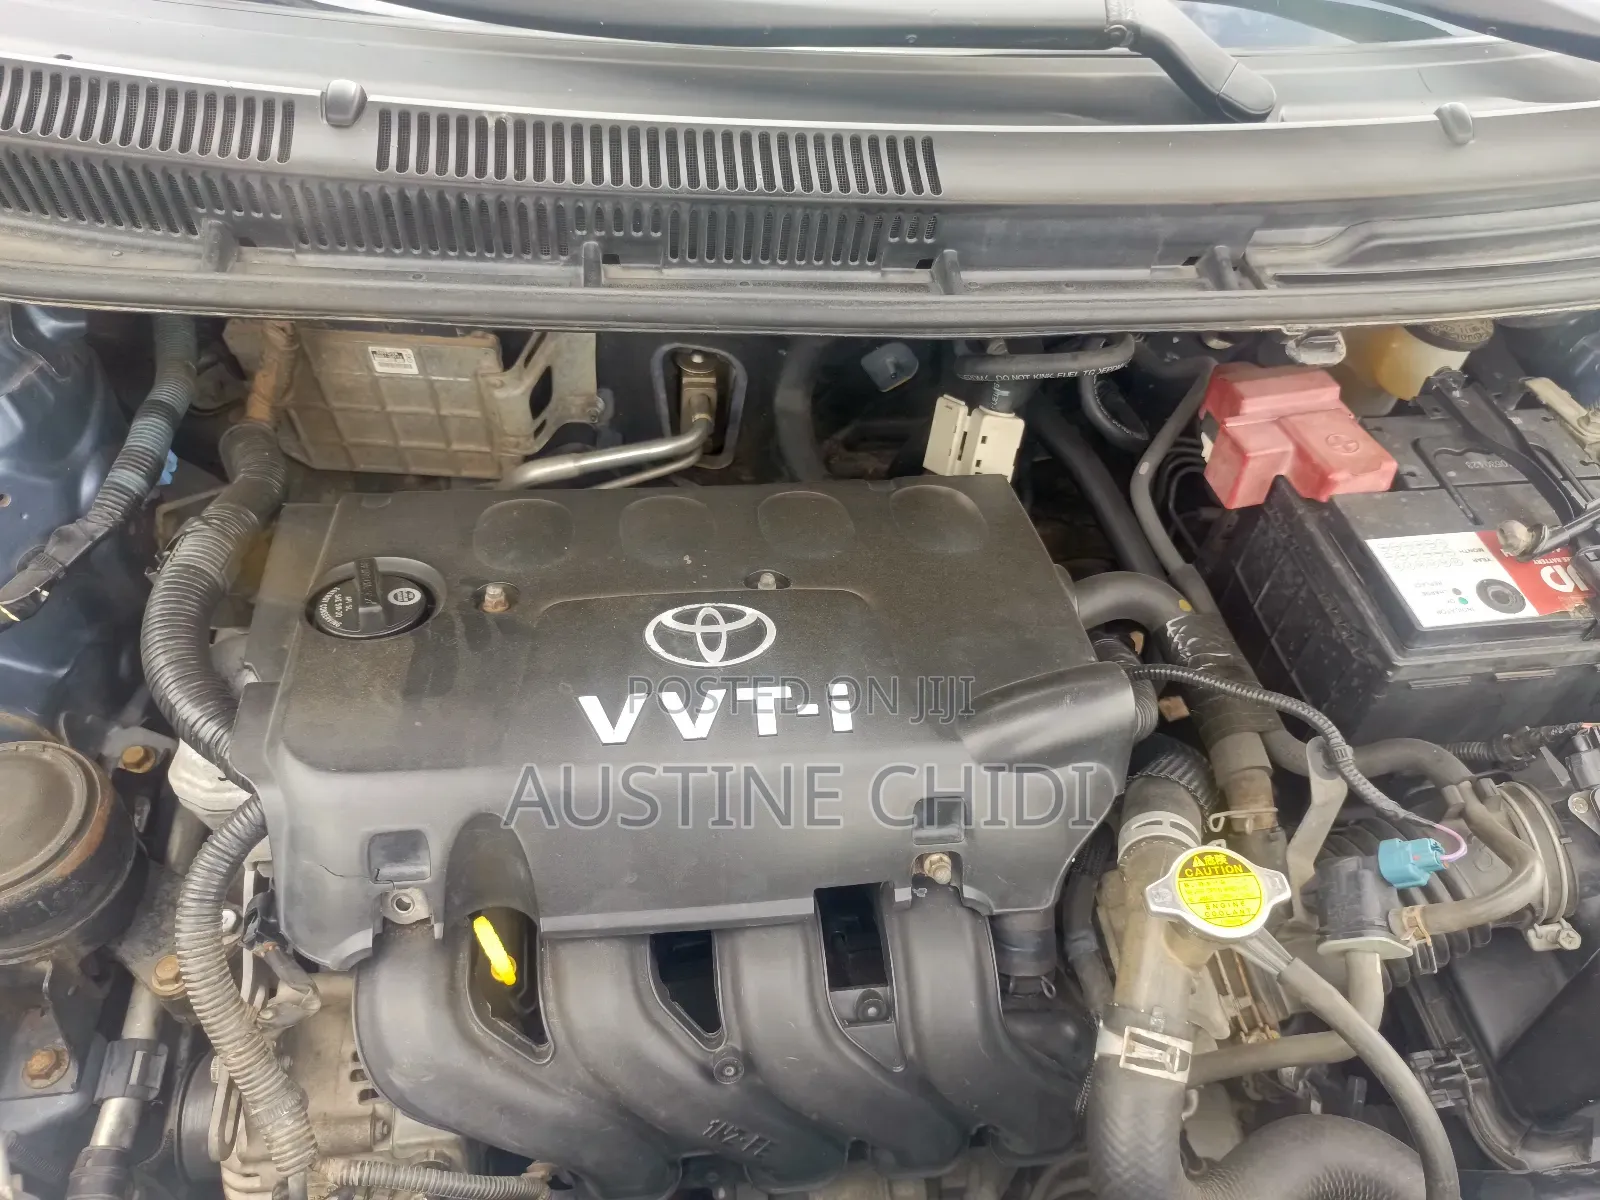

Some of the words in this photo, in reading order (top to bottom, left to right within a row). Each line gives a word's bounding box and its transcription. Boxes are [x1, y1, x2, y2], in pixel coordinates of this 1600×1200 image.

[1533, 557, 1562, 565] BATTERY
[1184, 864, 1244, 878] CAUTION
[1205, 900, 1246, 911] ENGINE
[1204, 908, 1252, 918] COOLANT
